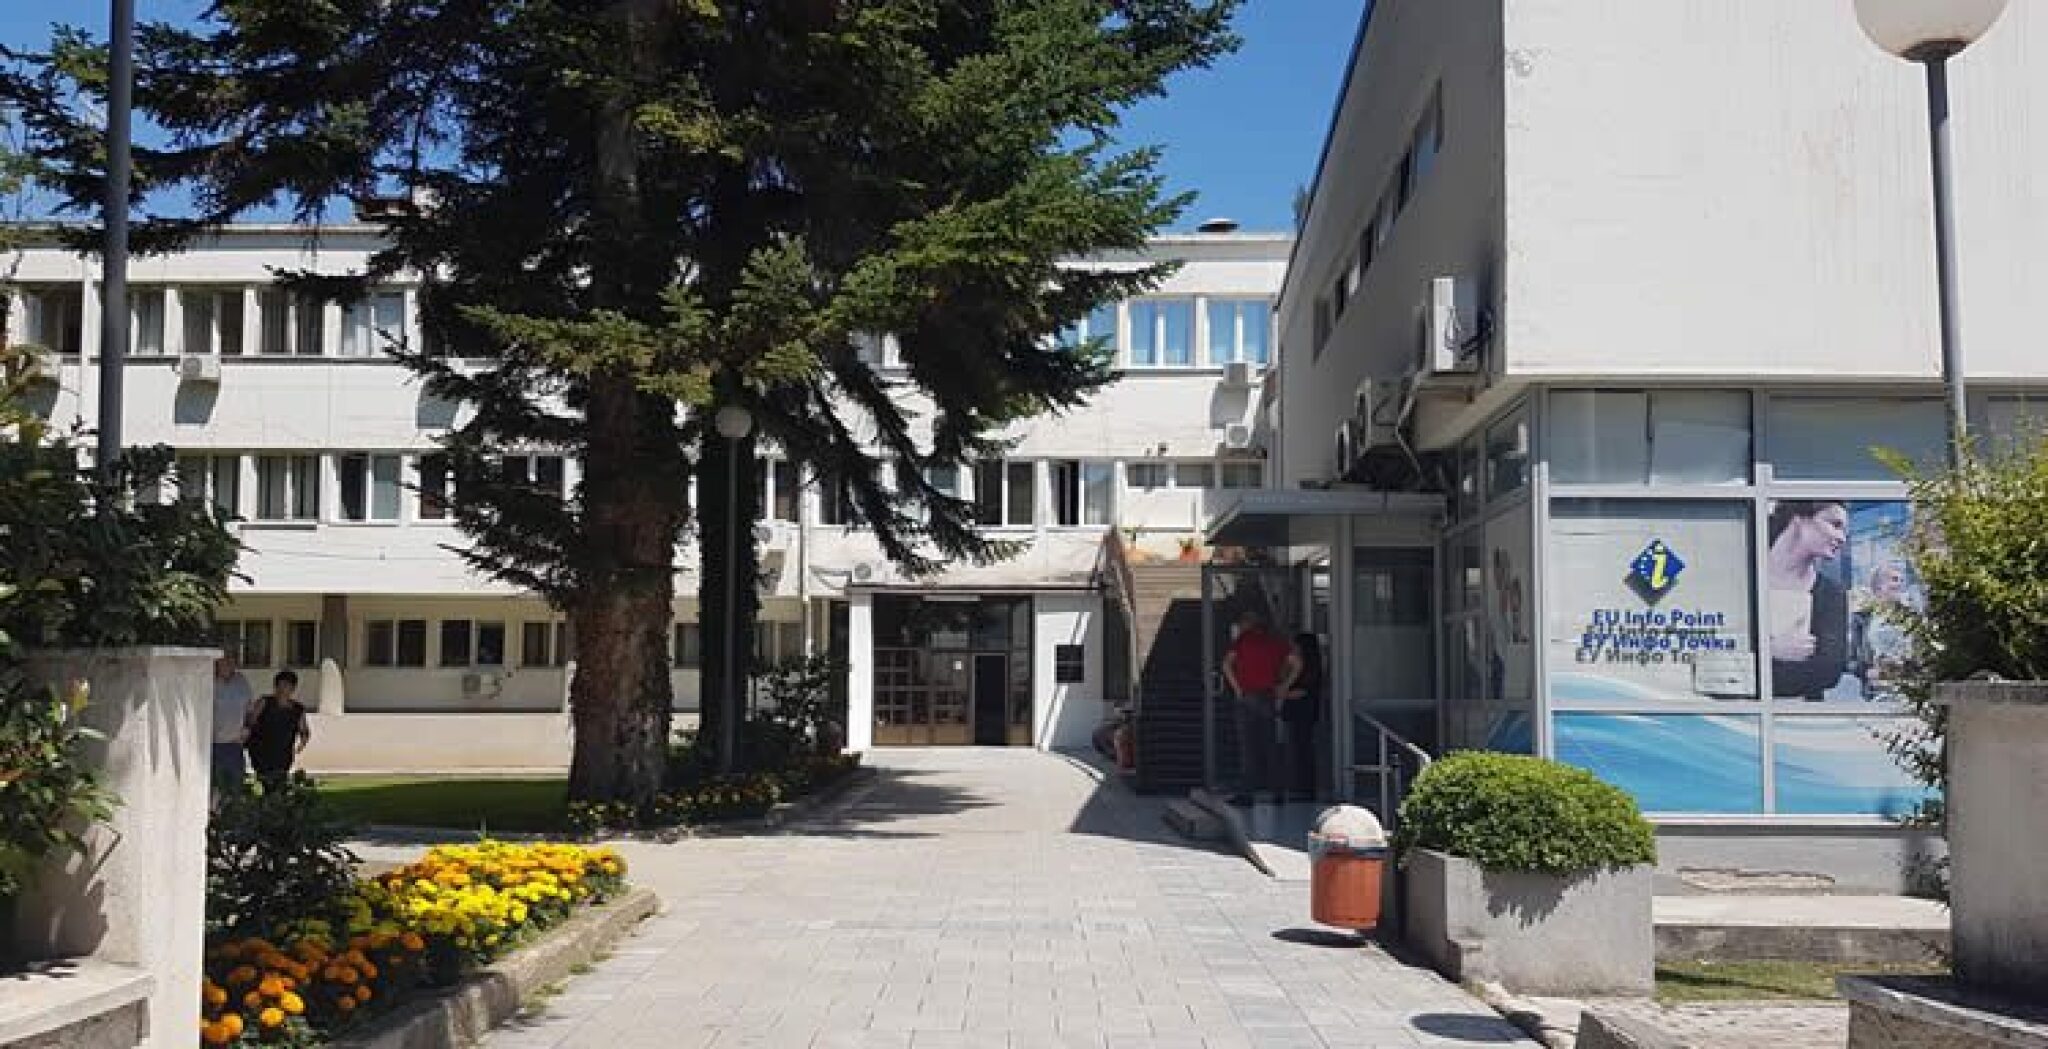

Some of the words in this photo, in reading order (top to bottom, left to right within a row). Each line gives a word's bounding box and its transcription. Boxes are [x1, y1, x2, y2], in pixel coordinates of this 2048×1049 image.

[1593, 609, 1620, 626] EU
[1625, 609, 1667, 626] Info
[1671, 609, 1724, 626] Point
[1613, 633, 1671, 652] Инфо
[1677, 633, 1736, 650] Точка
